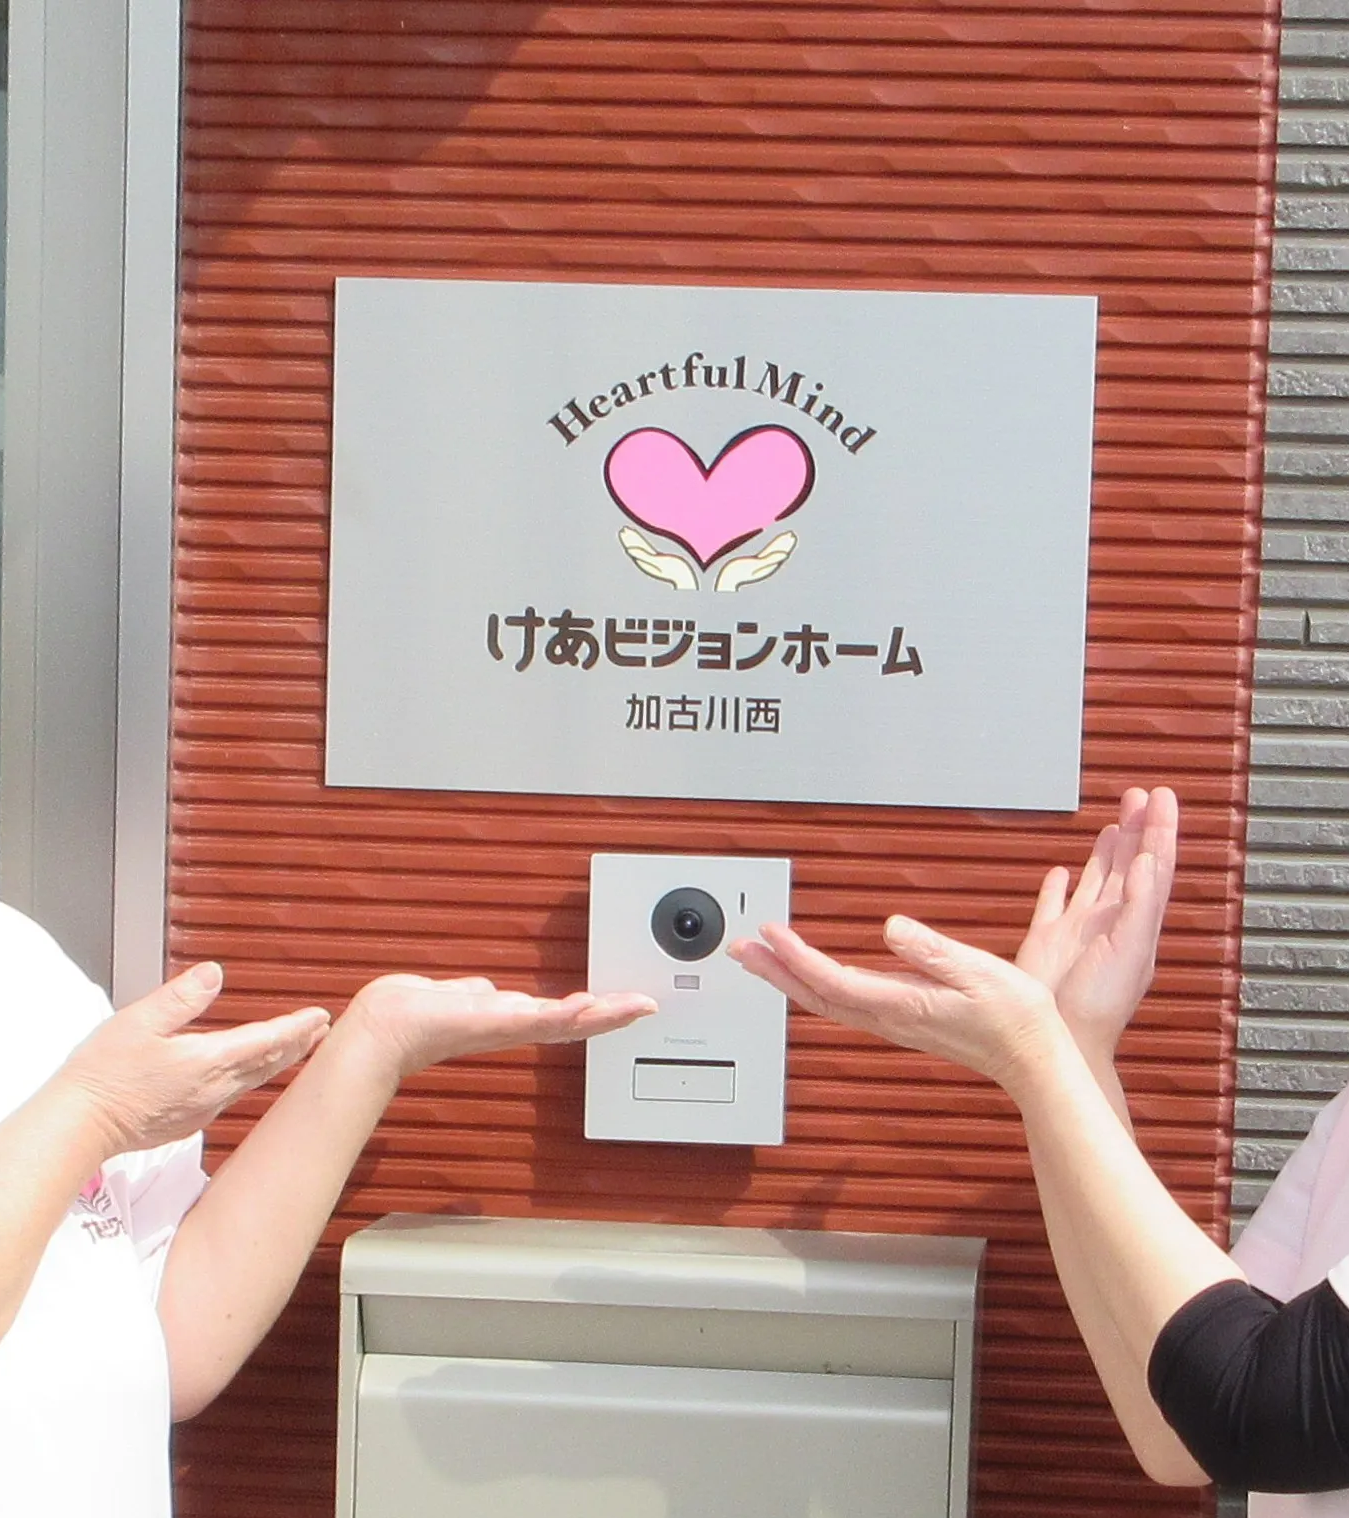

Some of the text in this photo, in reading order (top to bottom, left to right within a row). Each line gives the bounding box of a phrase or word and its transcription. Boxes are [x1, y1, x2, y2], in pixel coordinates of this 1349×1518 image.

[546, 352, 878, 456] Heartful Mind
[487, 606, 924, 677] けあビジョンホーム
[625, 694, 782, 734] 加古川西
